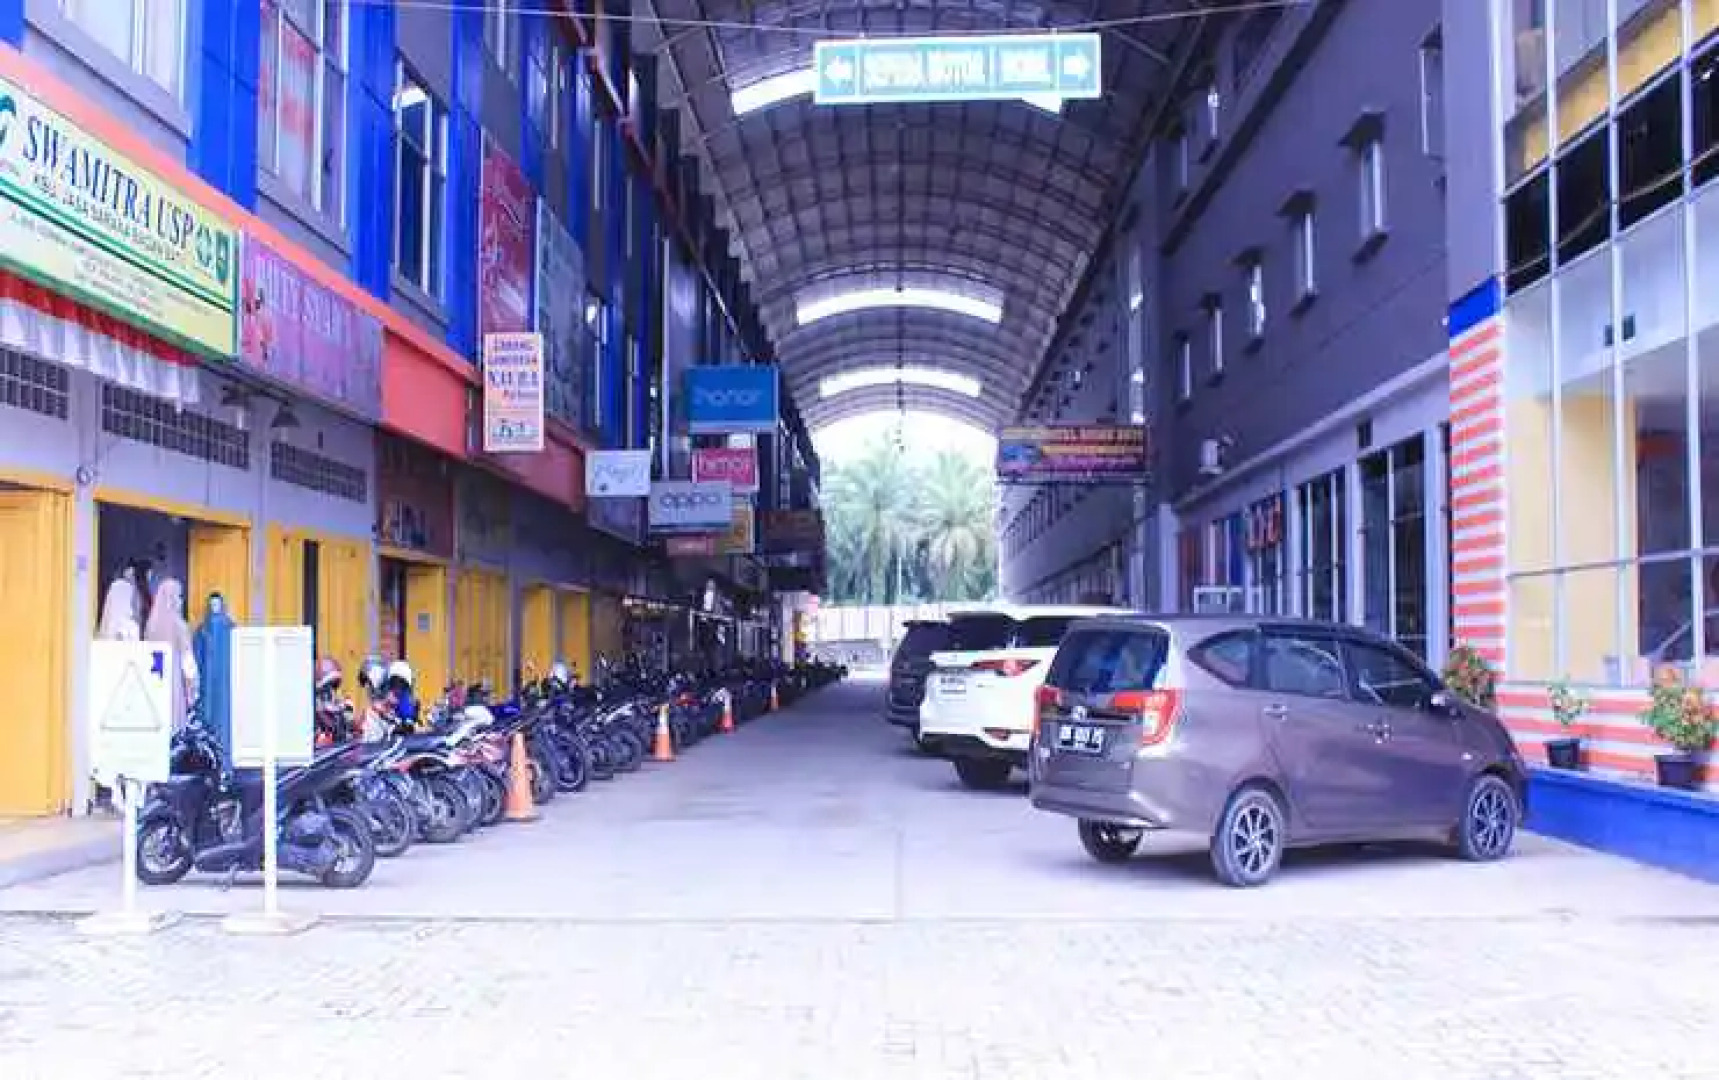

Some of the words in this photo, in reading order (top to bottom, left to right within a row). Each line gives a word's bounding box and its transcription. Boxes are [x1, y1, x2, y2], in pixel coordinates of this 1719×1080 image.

[22, 115, 152, 229] SWAMITRA
[157, 196, 195, 250] USP
[658, 491, 722, 511] oppo
